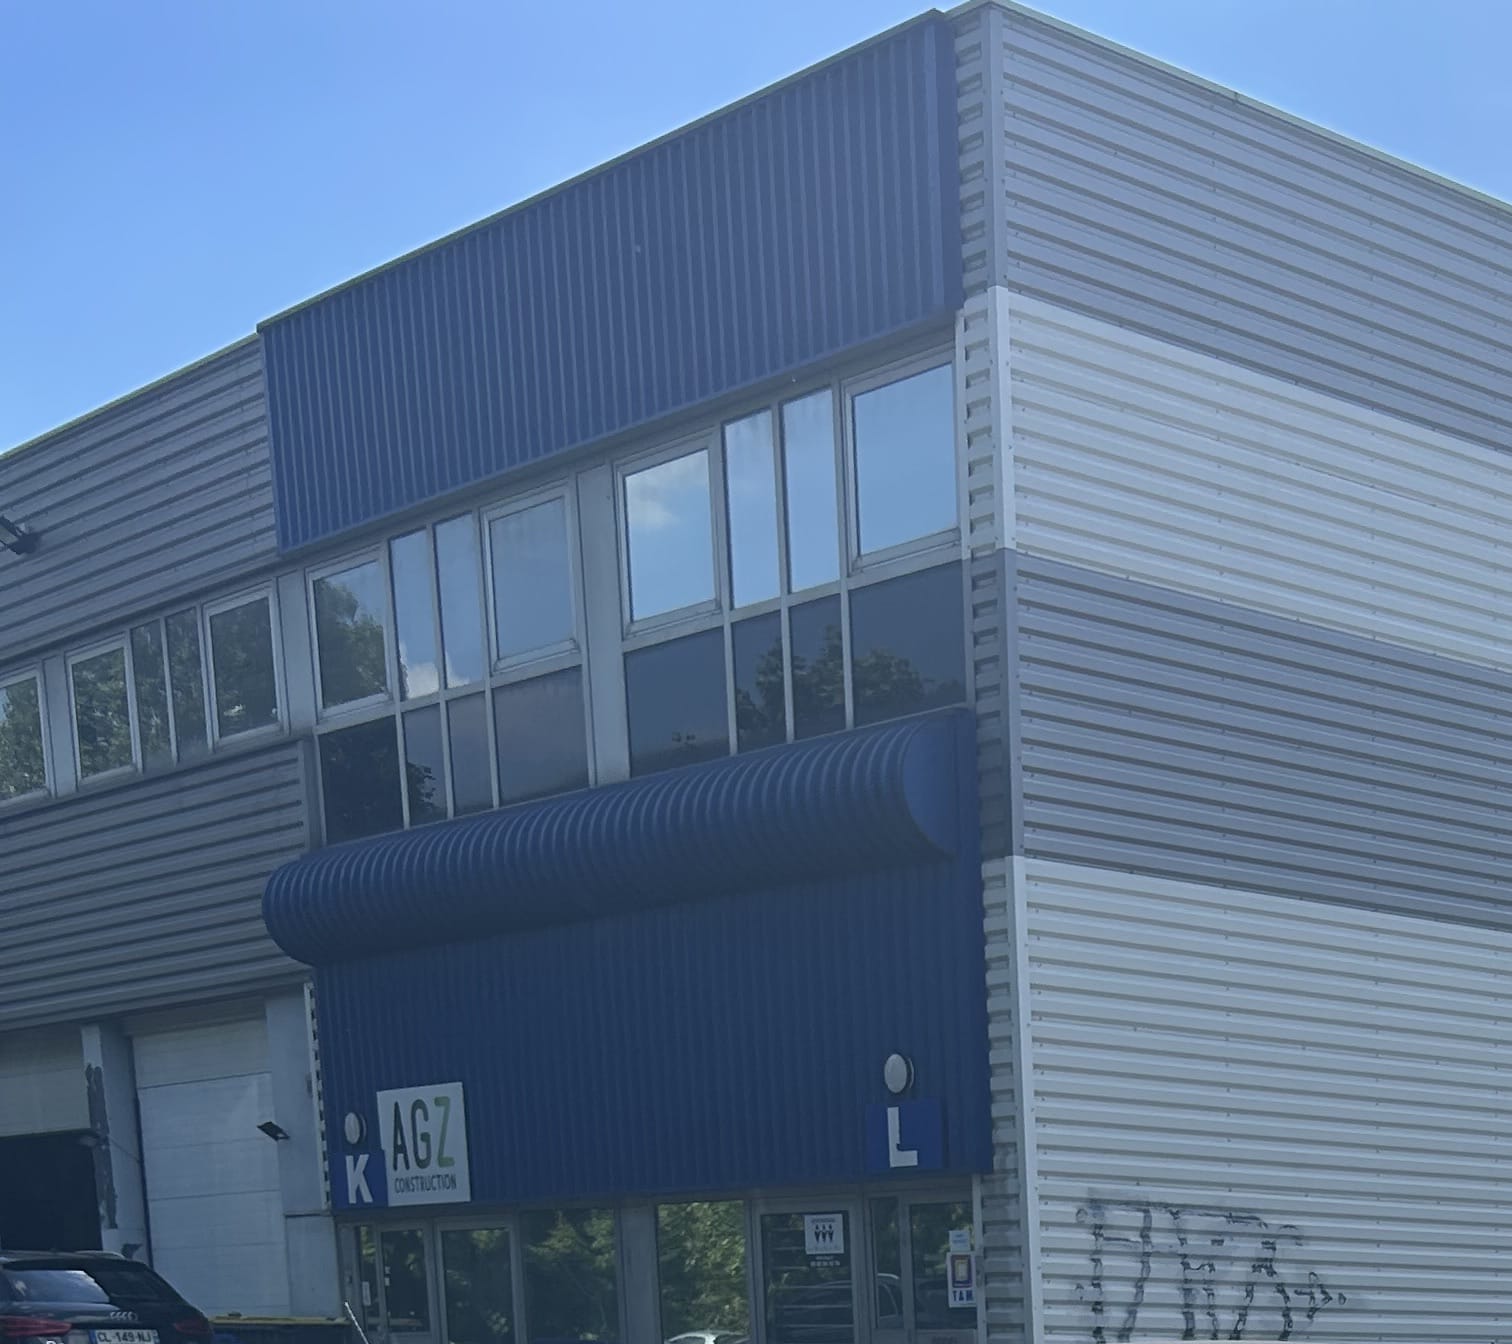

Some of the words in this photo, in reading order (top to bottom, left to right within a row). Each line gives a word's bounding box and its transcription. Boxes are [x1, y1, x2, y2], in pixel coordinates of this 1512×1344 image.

[393, 1096, 455, 1171] AGZ
[887, 1106, 918, 1168] L
[345, 1154, 373, 1204] K
[394, 1174, 457, 1194] CONSTRUCTION
